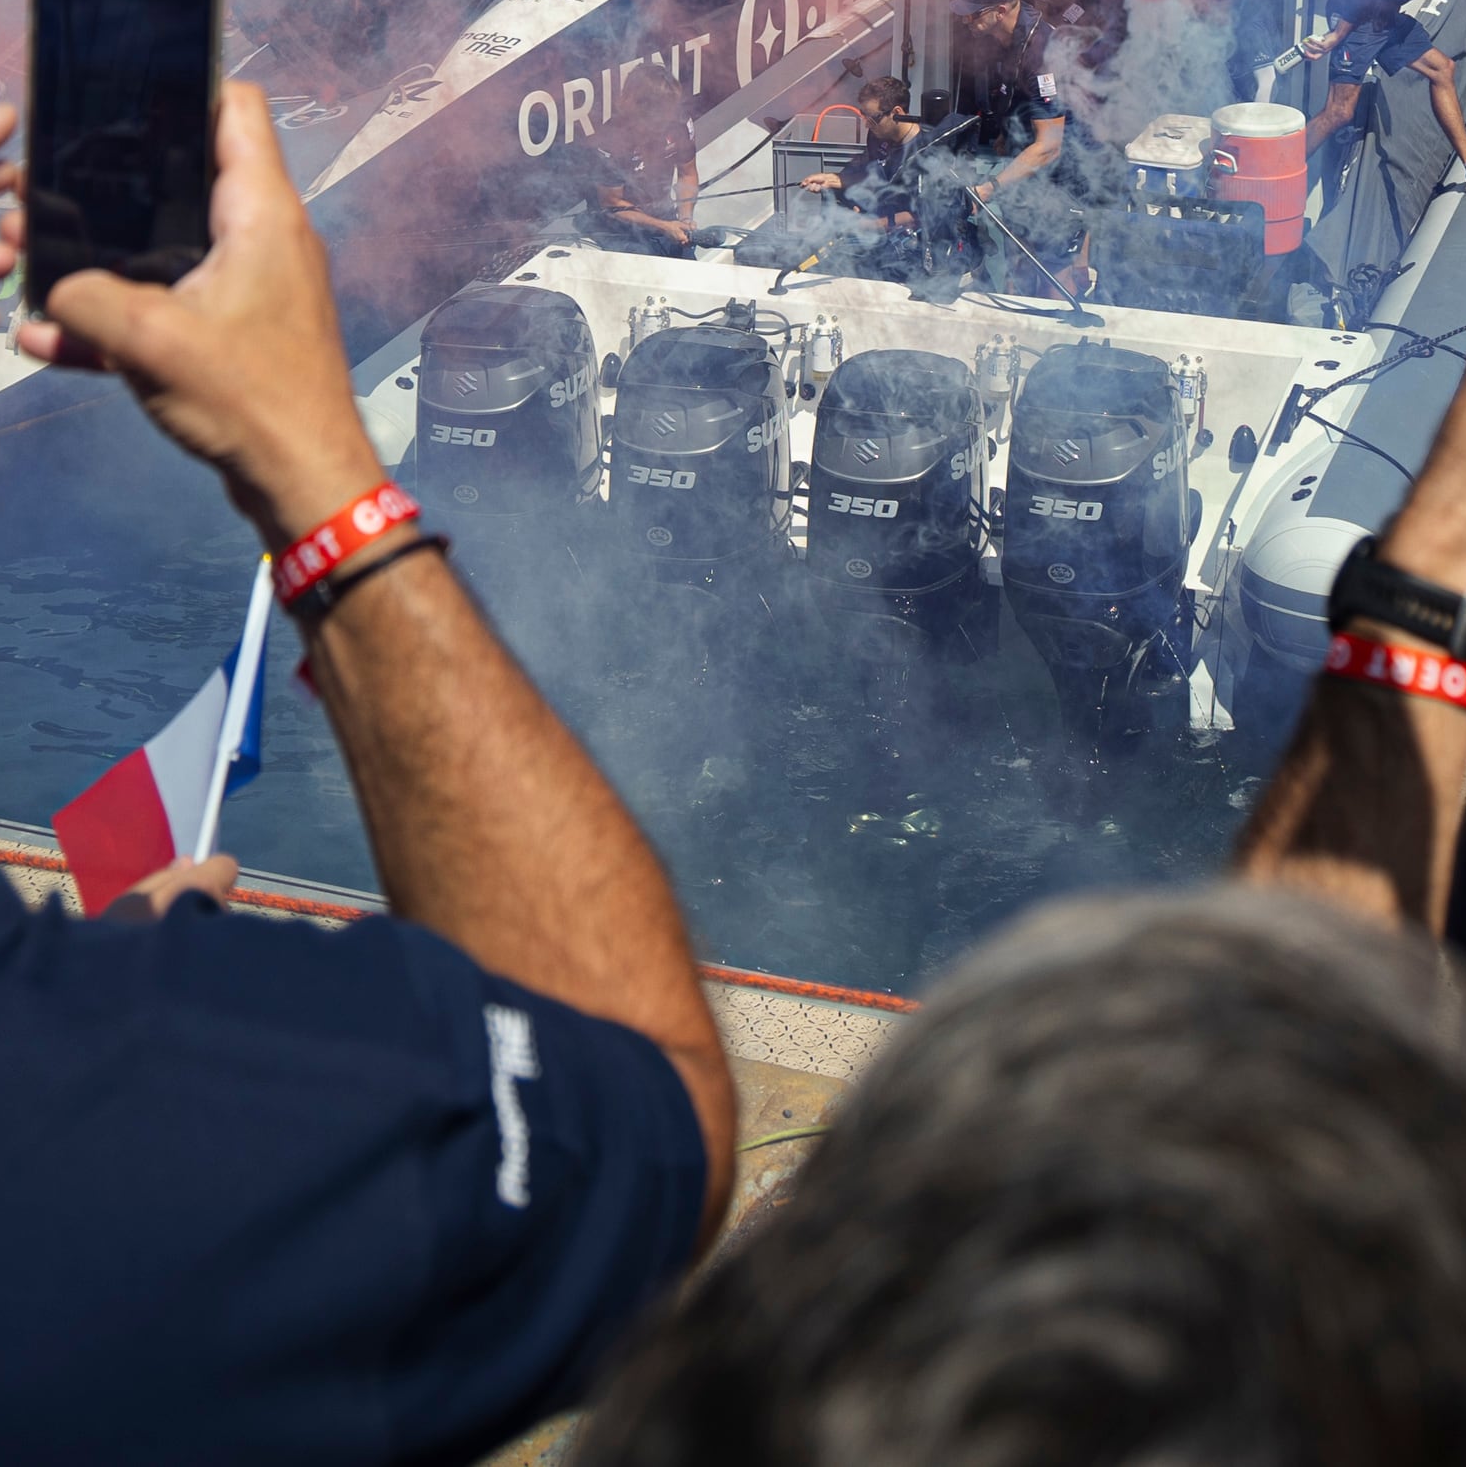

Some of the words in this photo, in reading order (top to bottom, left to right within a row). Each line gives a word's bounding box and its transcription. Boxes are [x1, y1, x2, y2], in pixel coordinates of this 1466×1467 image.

[464, 41, 513, 57] ME
[430, 423, 497, 447] 350
[627, 464, 696, 490] 350
[827, 492, 899, 519] 350
[1028, 495, 1103, 521] 350
